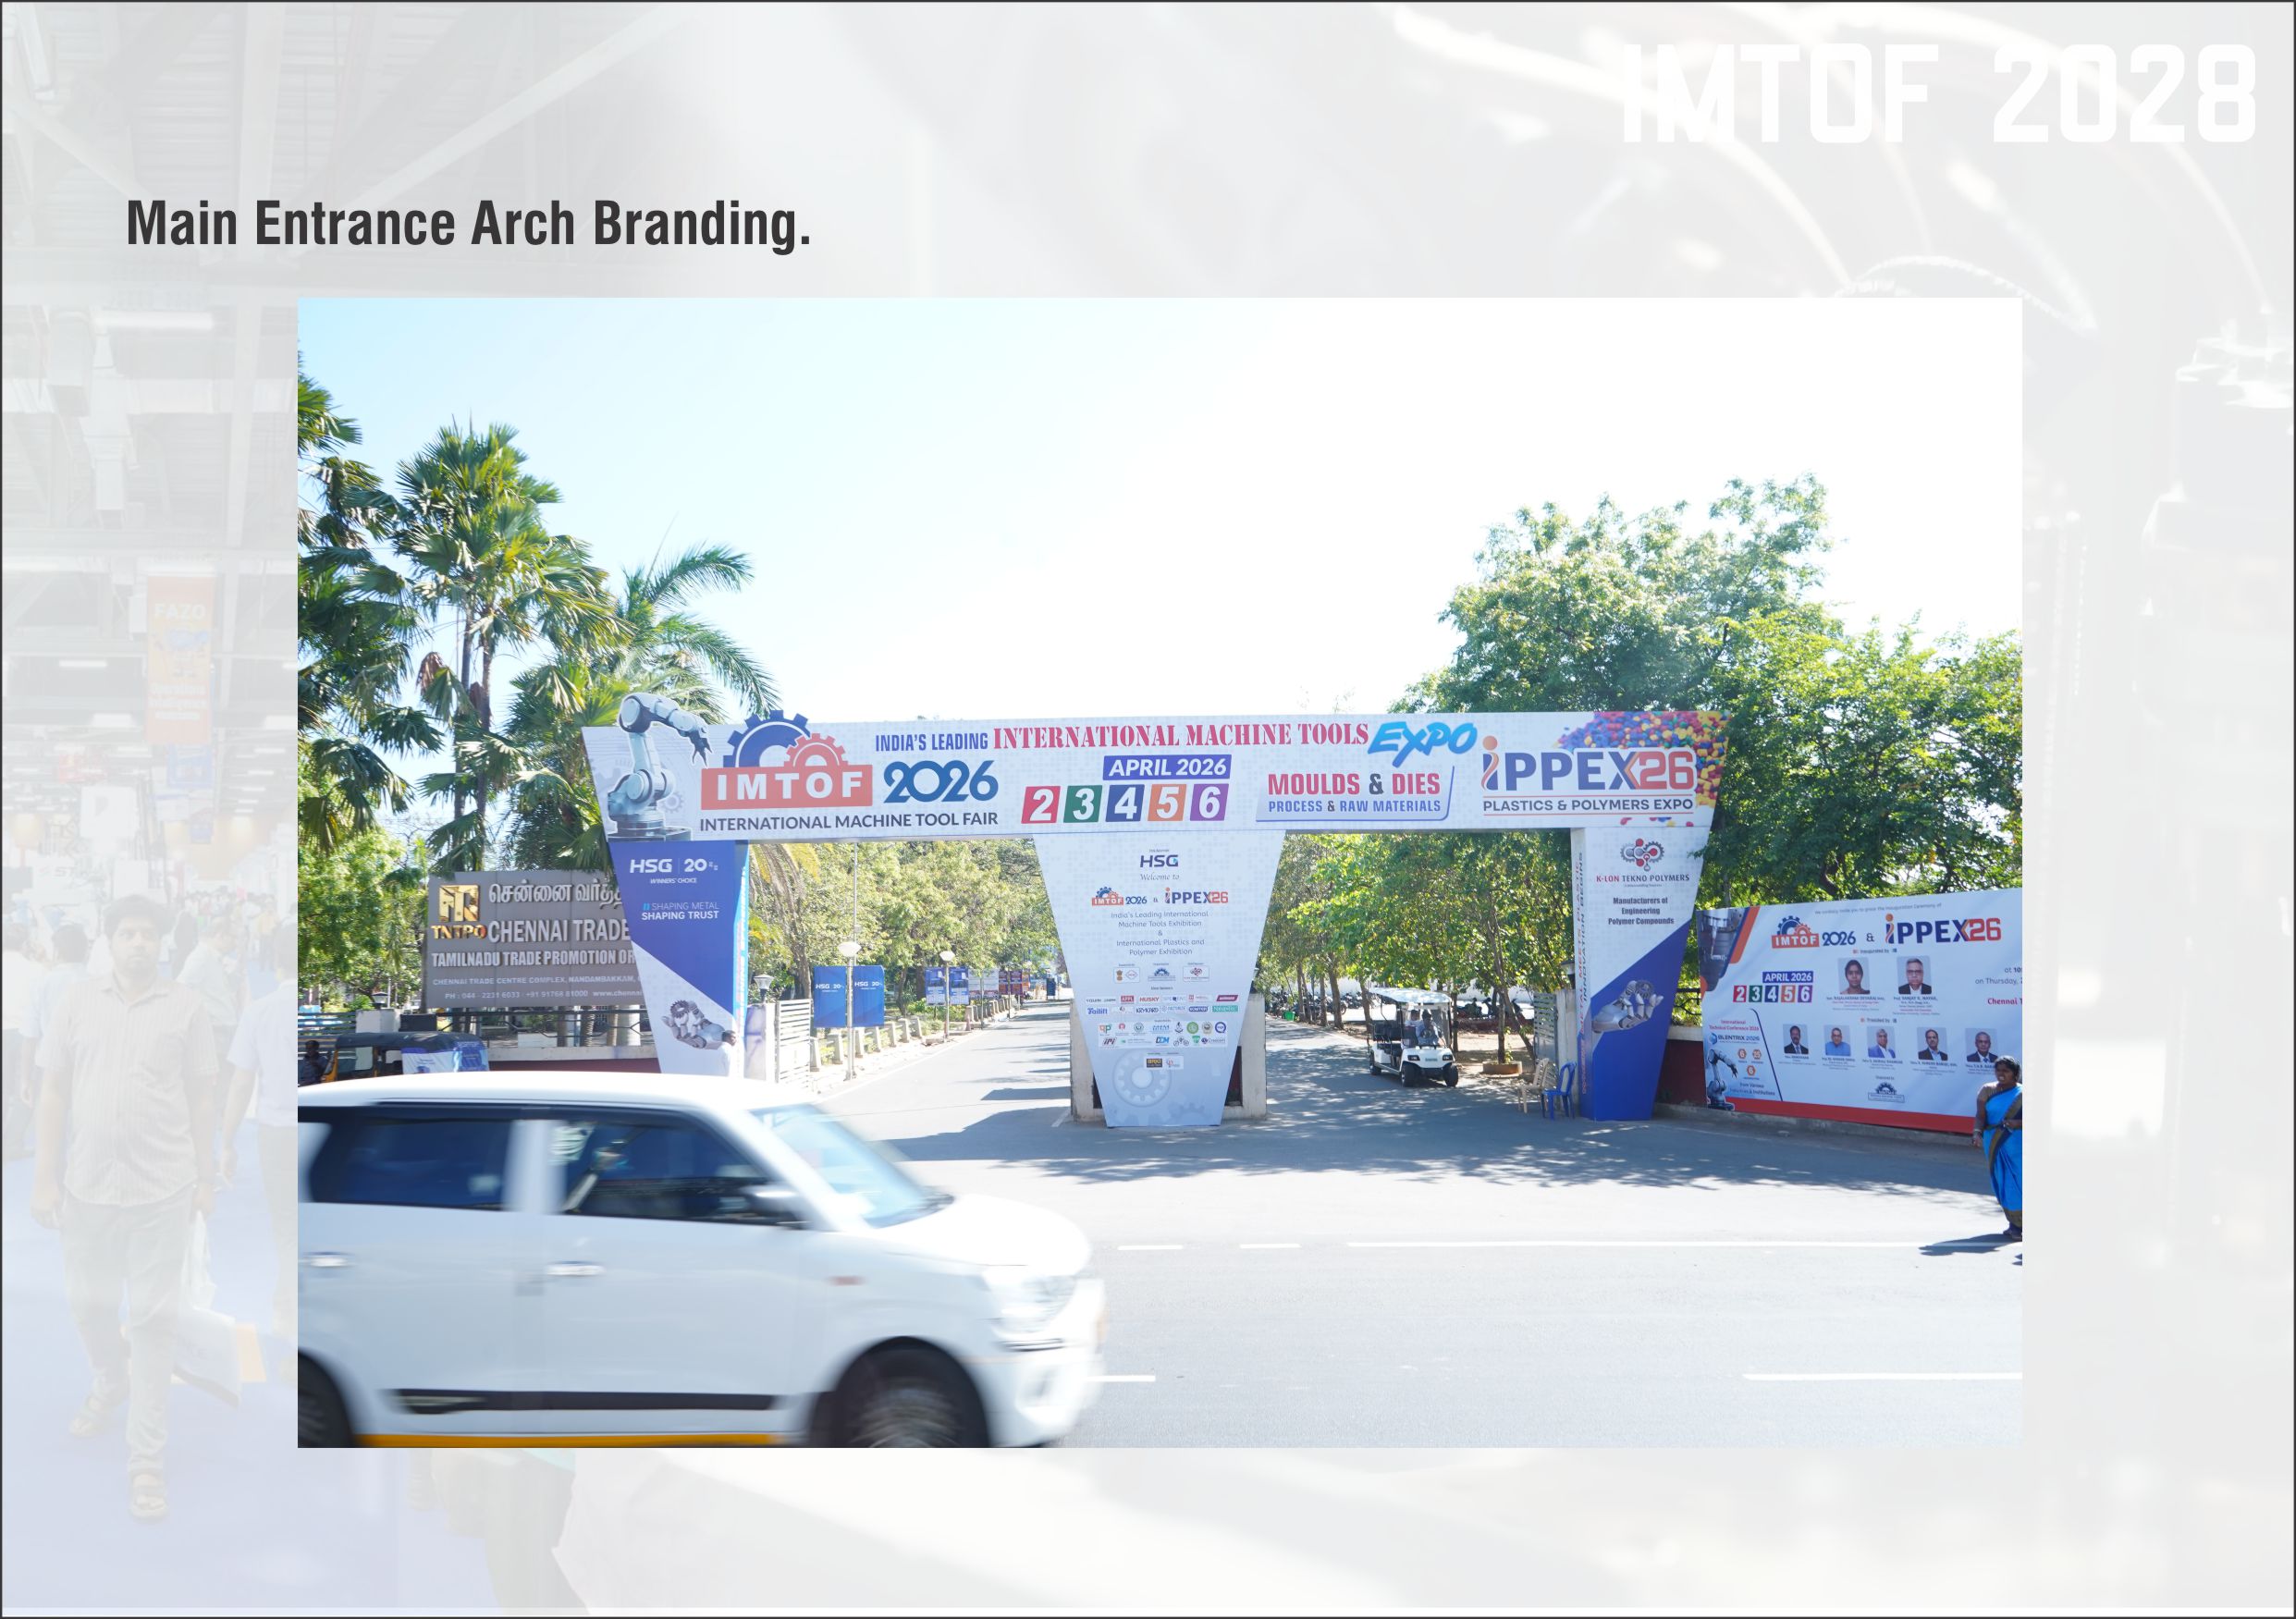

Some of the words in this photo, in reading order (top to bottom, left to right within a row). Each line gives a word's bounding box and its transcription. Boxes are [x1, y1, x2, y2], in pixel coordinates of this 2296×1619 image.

[931, 733, 988, 751] LEADING
[993, 724, 1180, 749] INTERNATIONAL
[1185, 724, 1292, 746] MACHINE
[1298, 723, 1369, 745] TOOLS
[1367, 721, 1478, 767] EXPO
[1109, 758, 1172, 777] APRIL
[1176, 757, 1227, 776] 2026
[718, 771, 861, 801] IMTOF
[884, 760, 998, 803] 2026
[1269, 773, 1360, 796] MOULDS
[1369, 774, 1383, 795] &
[1393, 773, 1441, 794] DIES
[1030, 789, 1054, 820] 2
[1073, 788, 1095, 820] 3
[1115, 786, 1137, 819] 4
[1156, 786, 1179, 818] 5
[1199, 786, 1222, 818] 6
[1269, 799, 1322, 813] PROCESS
[1327, 800, 1335, 812] &
[1340, 799, 1368, 812] RAW
[1373, 799, 1441, 812] MATERIALS
[1483, 799, 1553, 812] PLASTICS
[1557, 799, 1566, 812] &
[1572, 799, 1650, 812] POLYMERS
[1653, 798, 1693, 811] EXPO
[700, 815, 830, 832] INTERNATIONAL
[836, 814, 912, 830] MACHINE
[915, 813, 958, 828] TOOL
[964, 812, 998, 826] FAIR
[630, 858, 672, 874] HSG
[683, 858, 707, 873] 20
[1140, 854, 1179, 868] HSG
[1140, 872, 1170, 881] Welcome
[651, 902, 689, 911] SHAPING
[692, 901, 719, 910] METAL
[1125, 896, 1148, 905] 2026
[642, 912, 685, 921] SHAPING
[688, 911, 719, 919] TRUST
[1135, 911, 1162, 919] Leading
[431, 925, 487, 939] TNTPO
[488, 918, 569, 943] CHENNAI
[570, 918, 631, 942] TRADE
[1775, 934, 1817, 945] IMTOF
[1822, 931, 1857, 946] 2026
[1866, 933, 1875, 942] &
[432, 951, 502, 968] TAMILNADU
[502, 951, 542, 966] TRADE
[545, 950, 617, 966] PROMOTION
[469, 977, 495, 986] TRADE
[1764, 973, 1790, 983] APRIL
[1790, 971, 1812, 982] 2026
[1736, 987, 1745, 1002] 2
[1751, 987, 1761, 1001] 3
[1767, 986, 1777, 1001] 4
[1784, 986, 1793, 1001] 5
[1800, 986, 1810, 1001] 6
